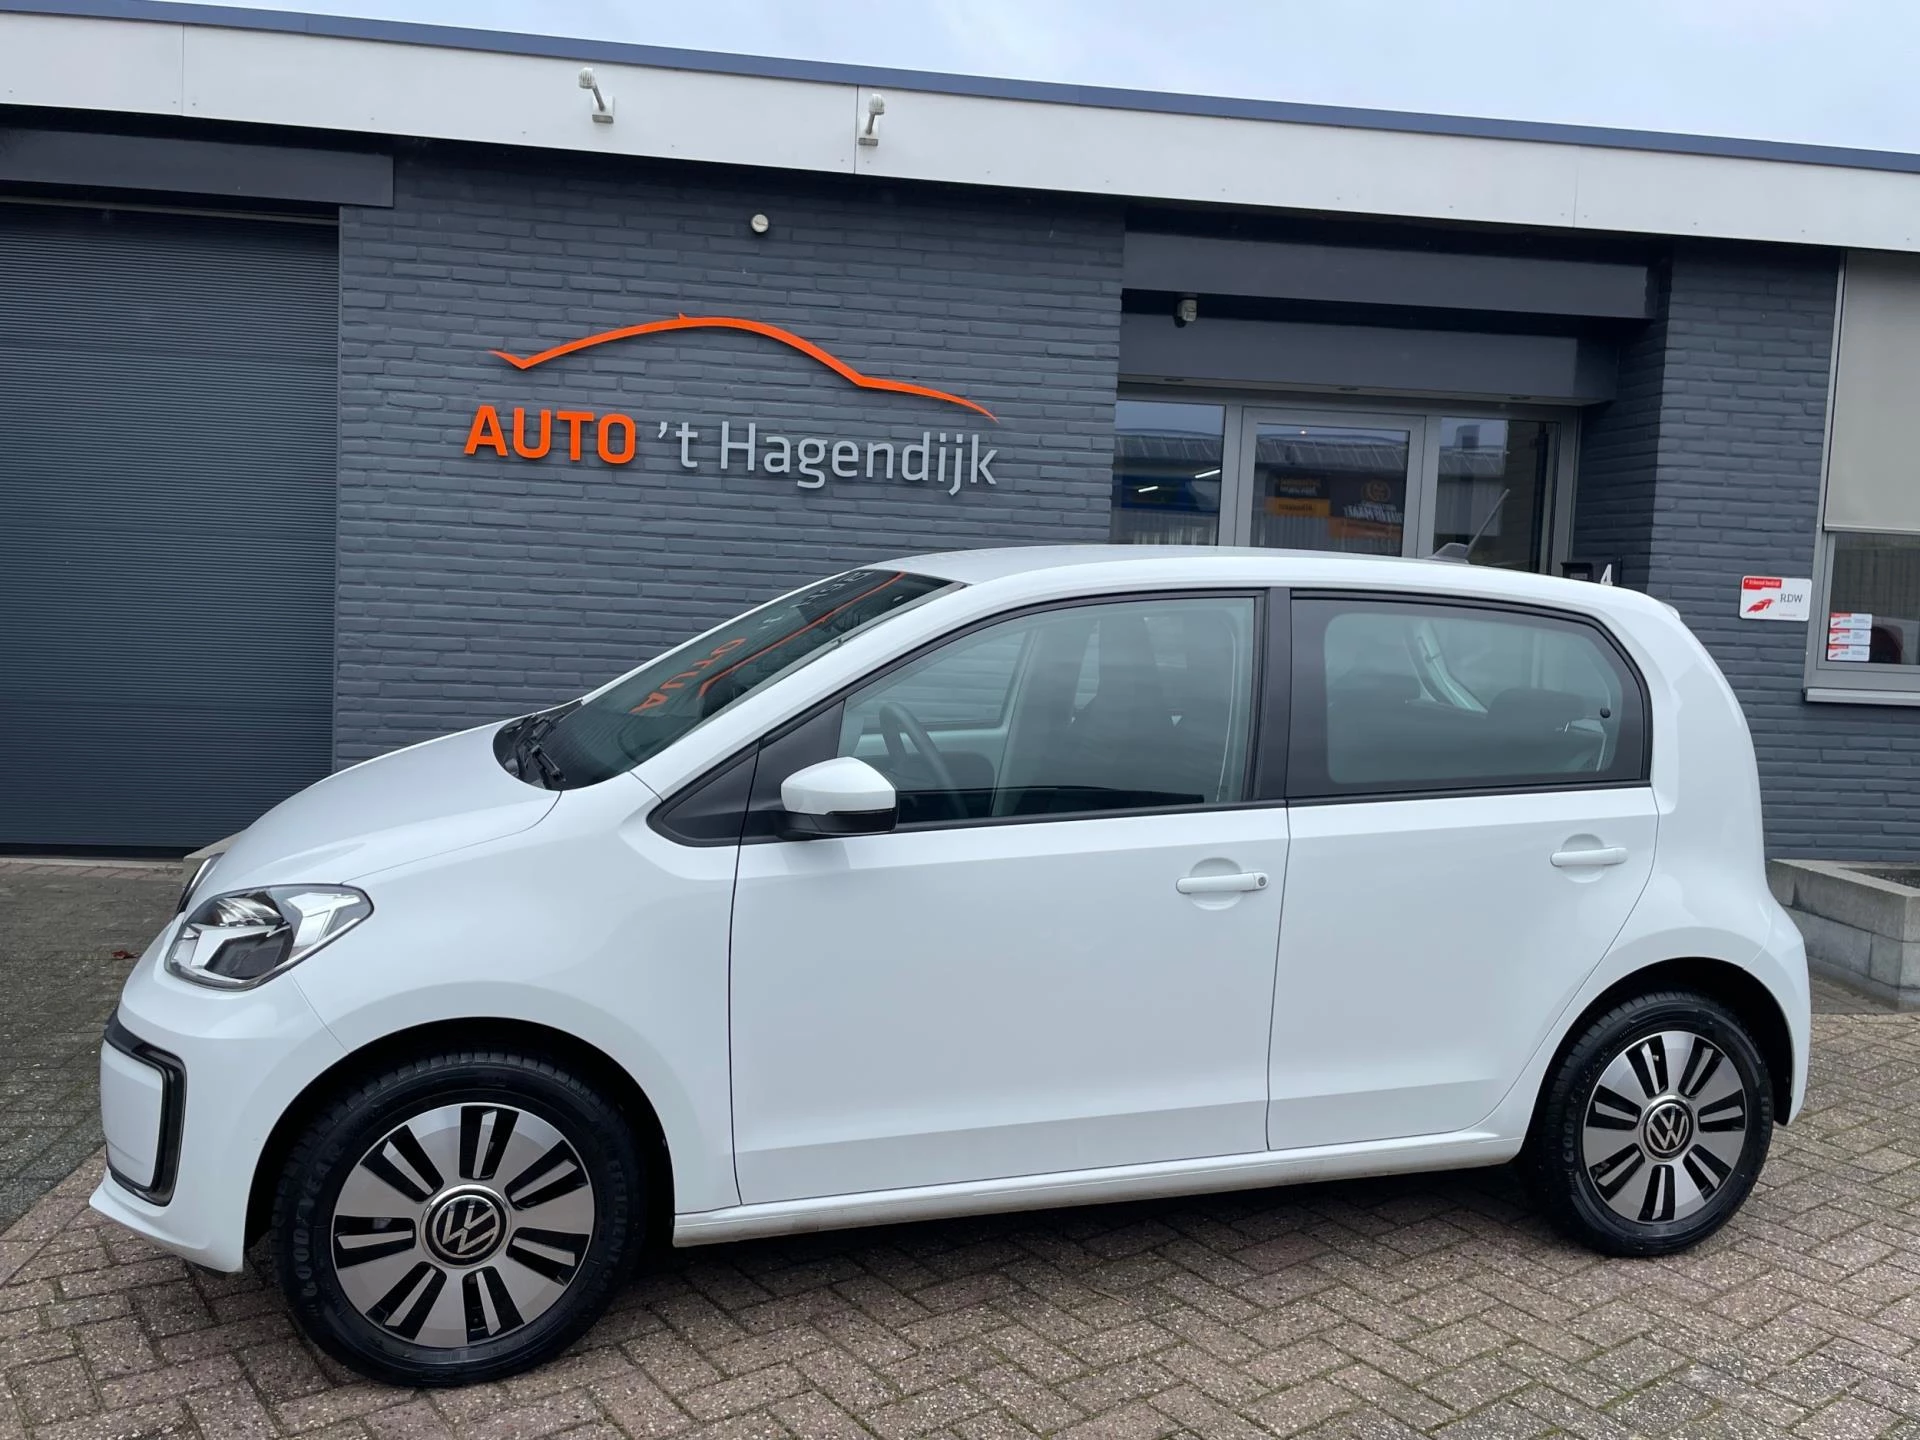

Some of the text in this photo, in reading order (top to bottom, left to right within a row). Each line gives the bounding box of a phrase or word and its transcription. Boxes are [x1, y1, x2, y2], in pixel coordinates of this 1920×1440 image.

[464, 405, 637, 464] AUTO
[720, 421, 998, 496] Hagendijk
[1600, 563, 1613, 586] 4
[1780, 593, 1803, 603] RDW
